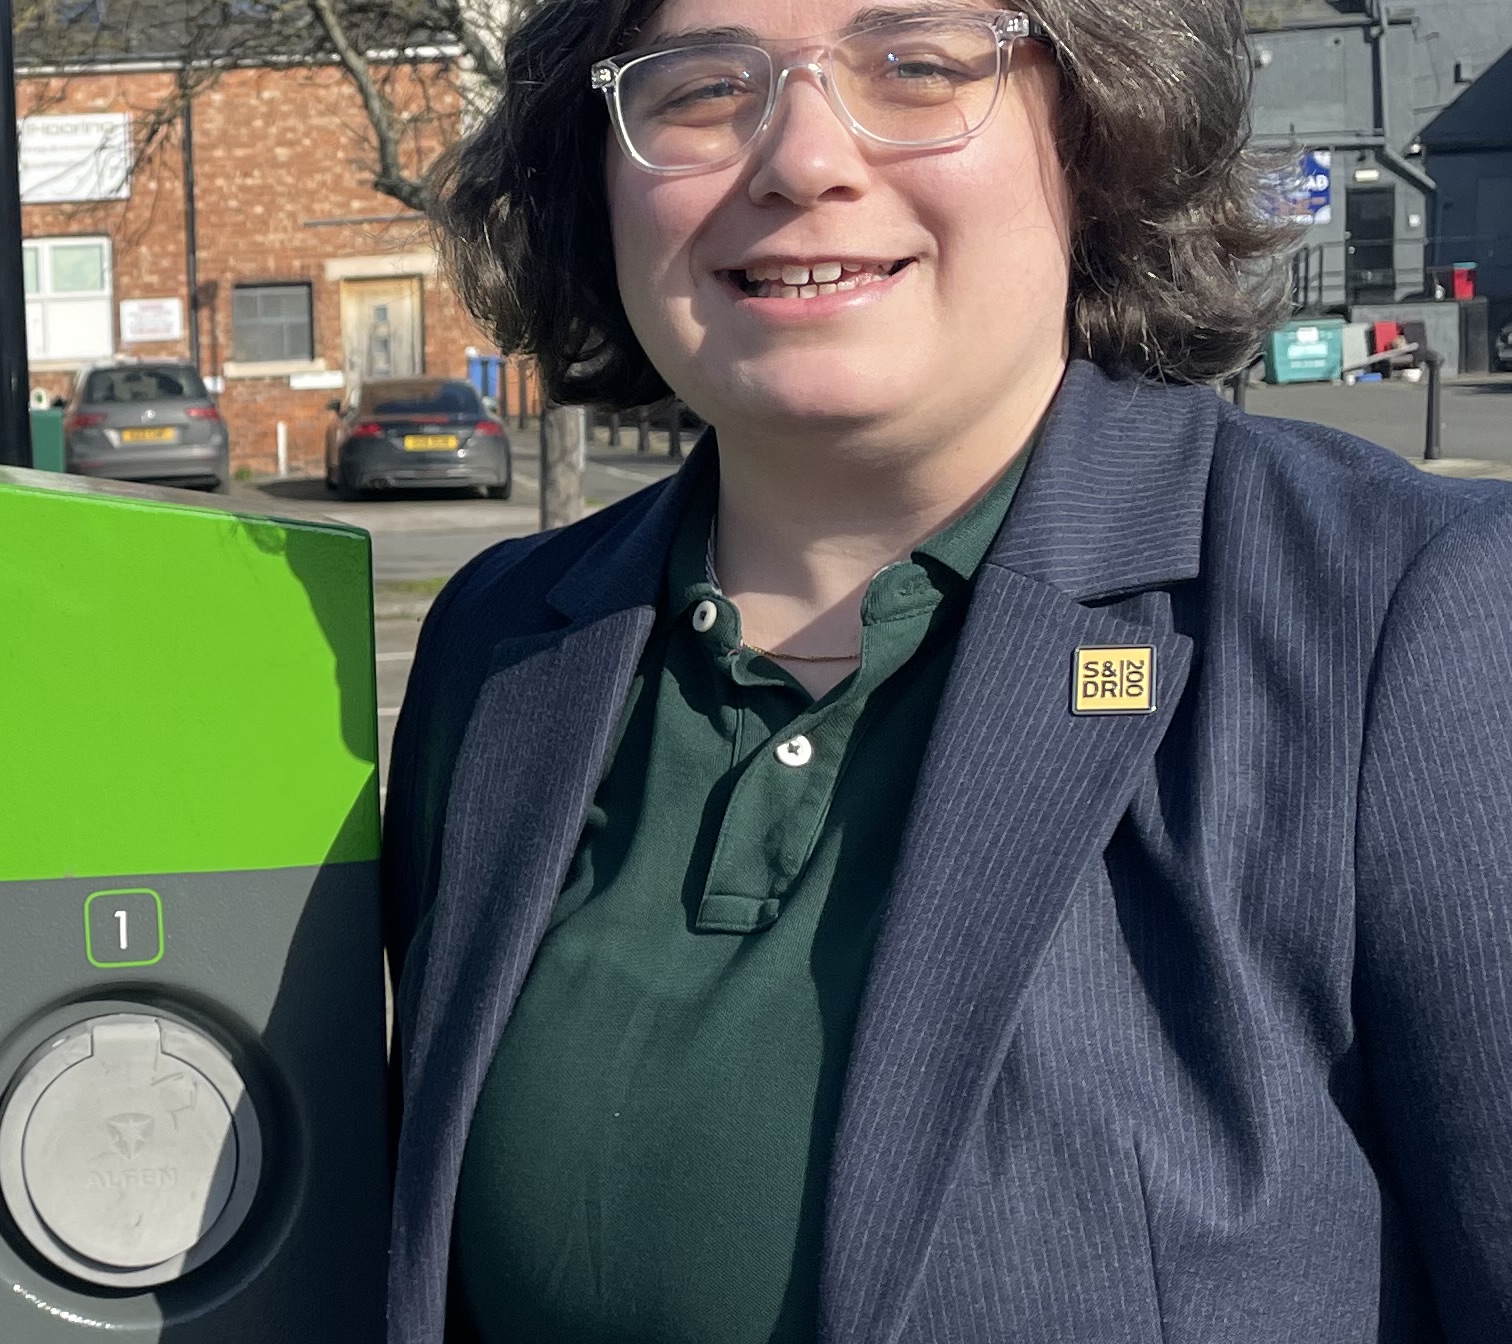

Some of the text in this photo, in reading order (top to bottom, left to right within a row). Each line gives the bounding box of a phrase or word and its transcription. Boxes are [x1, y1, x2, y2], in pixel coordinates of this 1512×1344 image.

[1082, 660, 1117, 678] S&
[1082, 680, 1118, 698] DR
[114, 909, 128, 951] 1
